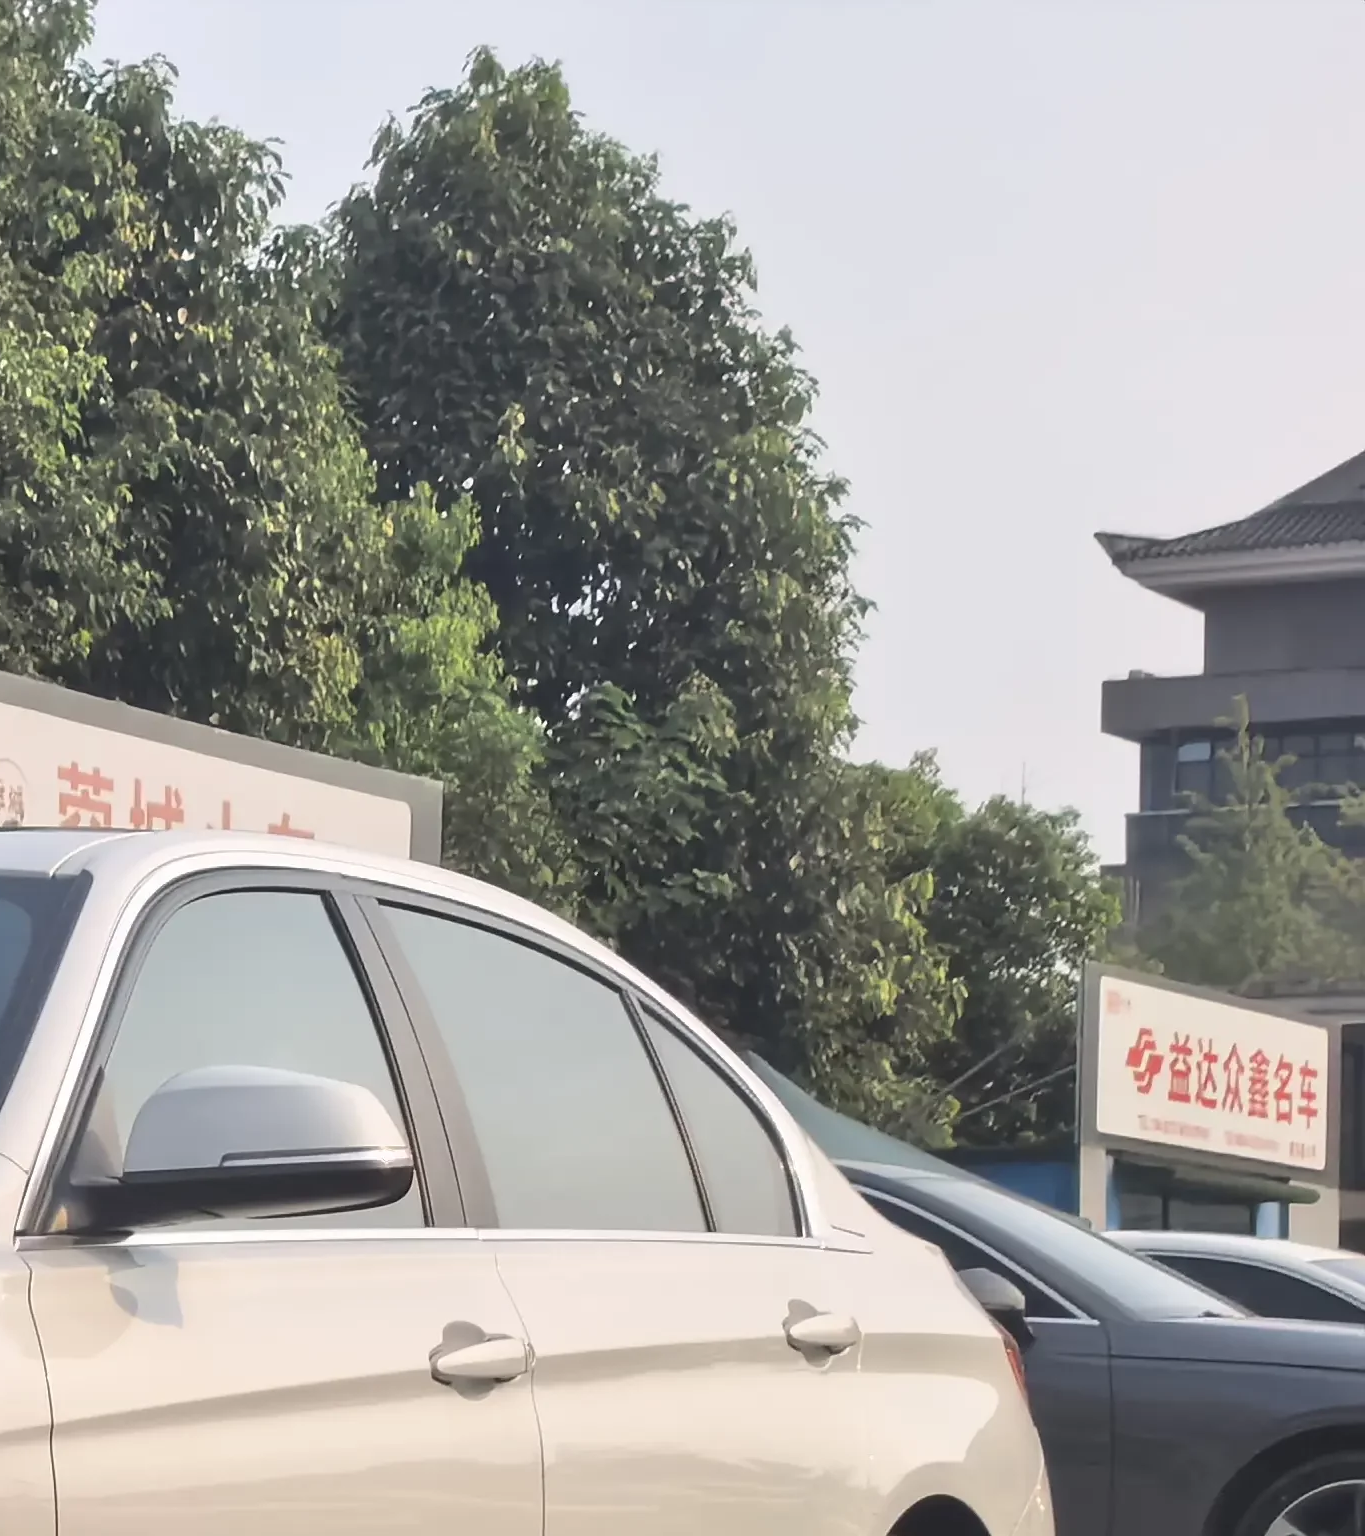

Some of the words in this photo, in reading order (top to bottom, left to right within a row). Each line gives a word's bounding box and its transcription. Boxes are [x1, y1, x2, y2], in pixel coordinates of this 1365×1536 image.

[1168, 1031, 1318, 1129] 益达众鑫名车
